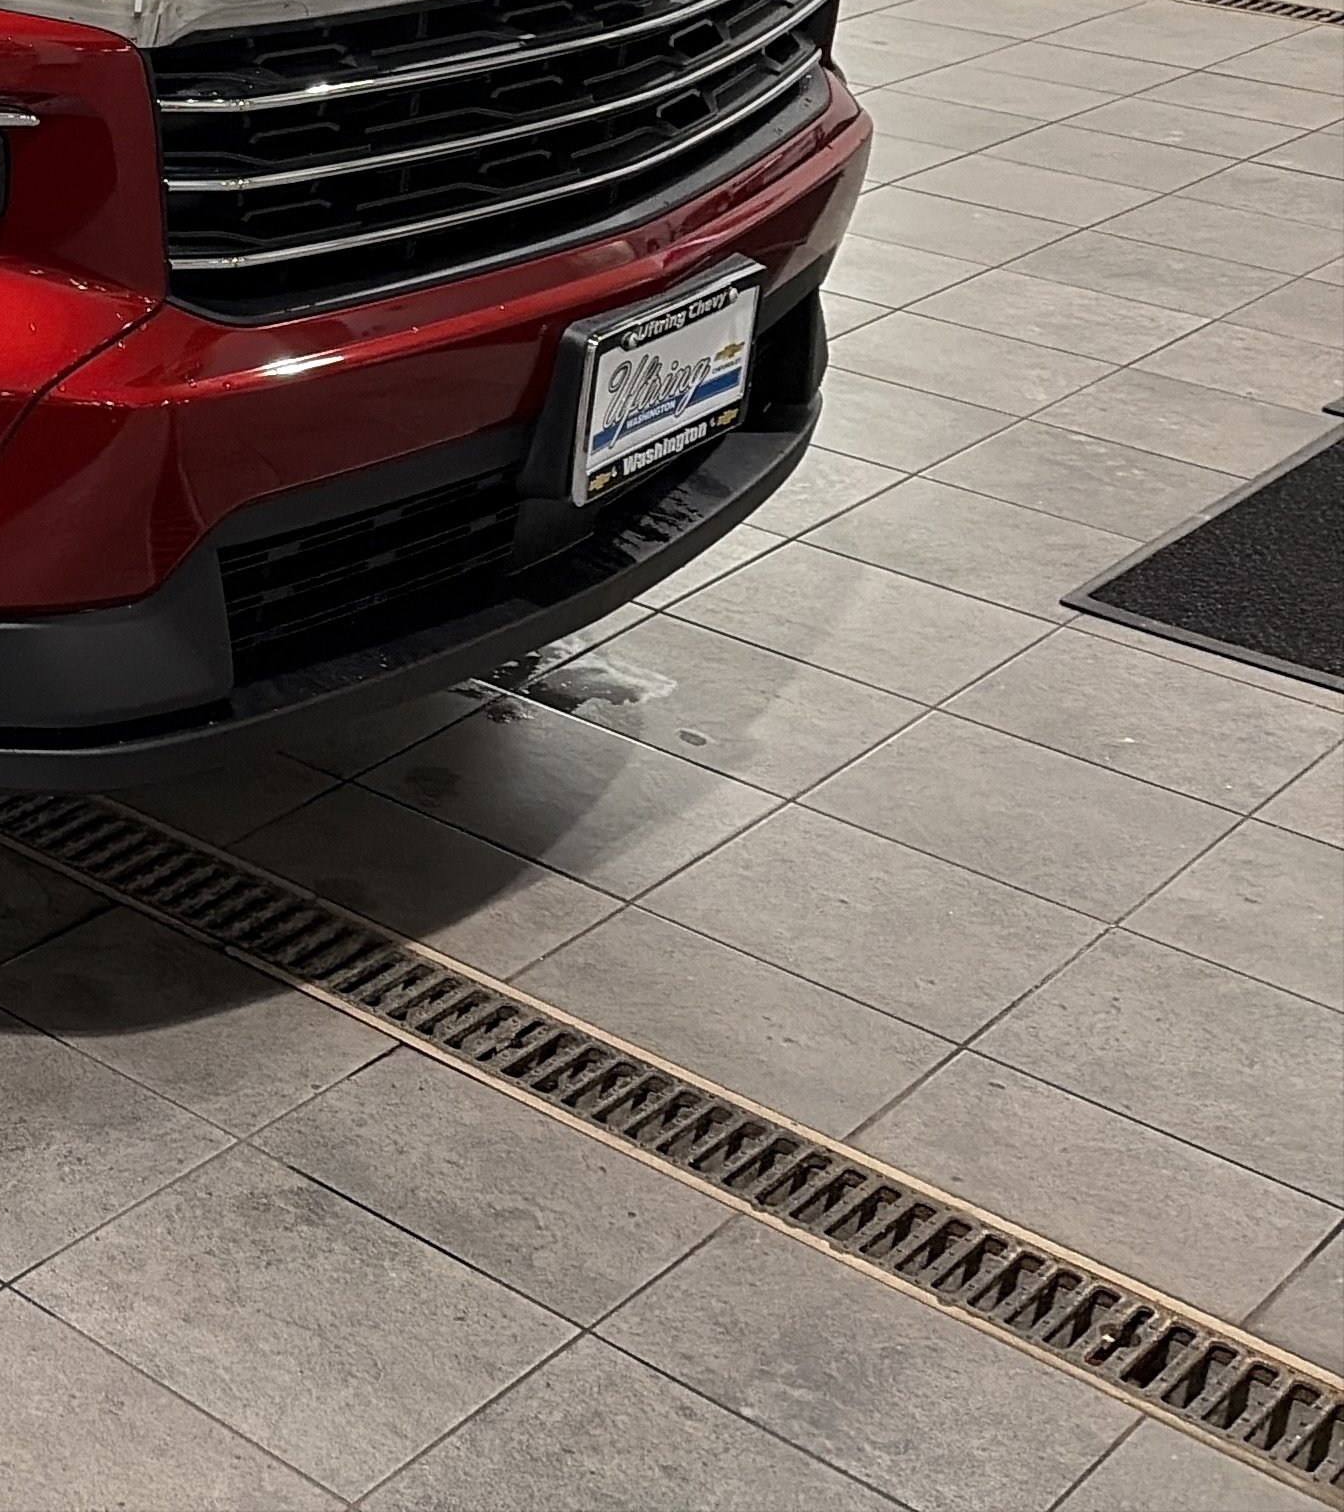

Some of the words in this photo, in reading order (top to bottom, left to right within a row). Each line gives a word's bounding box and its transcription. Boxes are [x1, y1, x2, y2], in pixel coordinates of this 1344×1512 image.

[689, 291, 728, 319] Chevy
[626, 399, 676, 429] WASHINGTON
[623, 421, 707, 476] Washington
